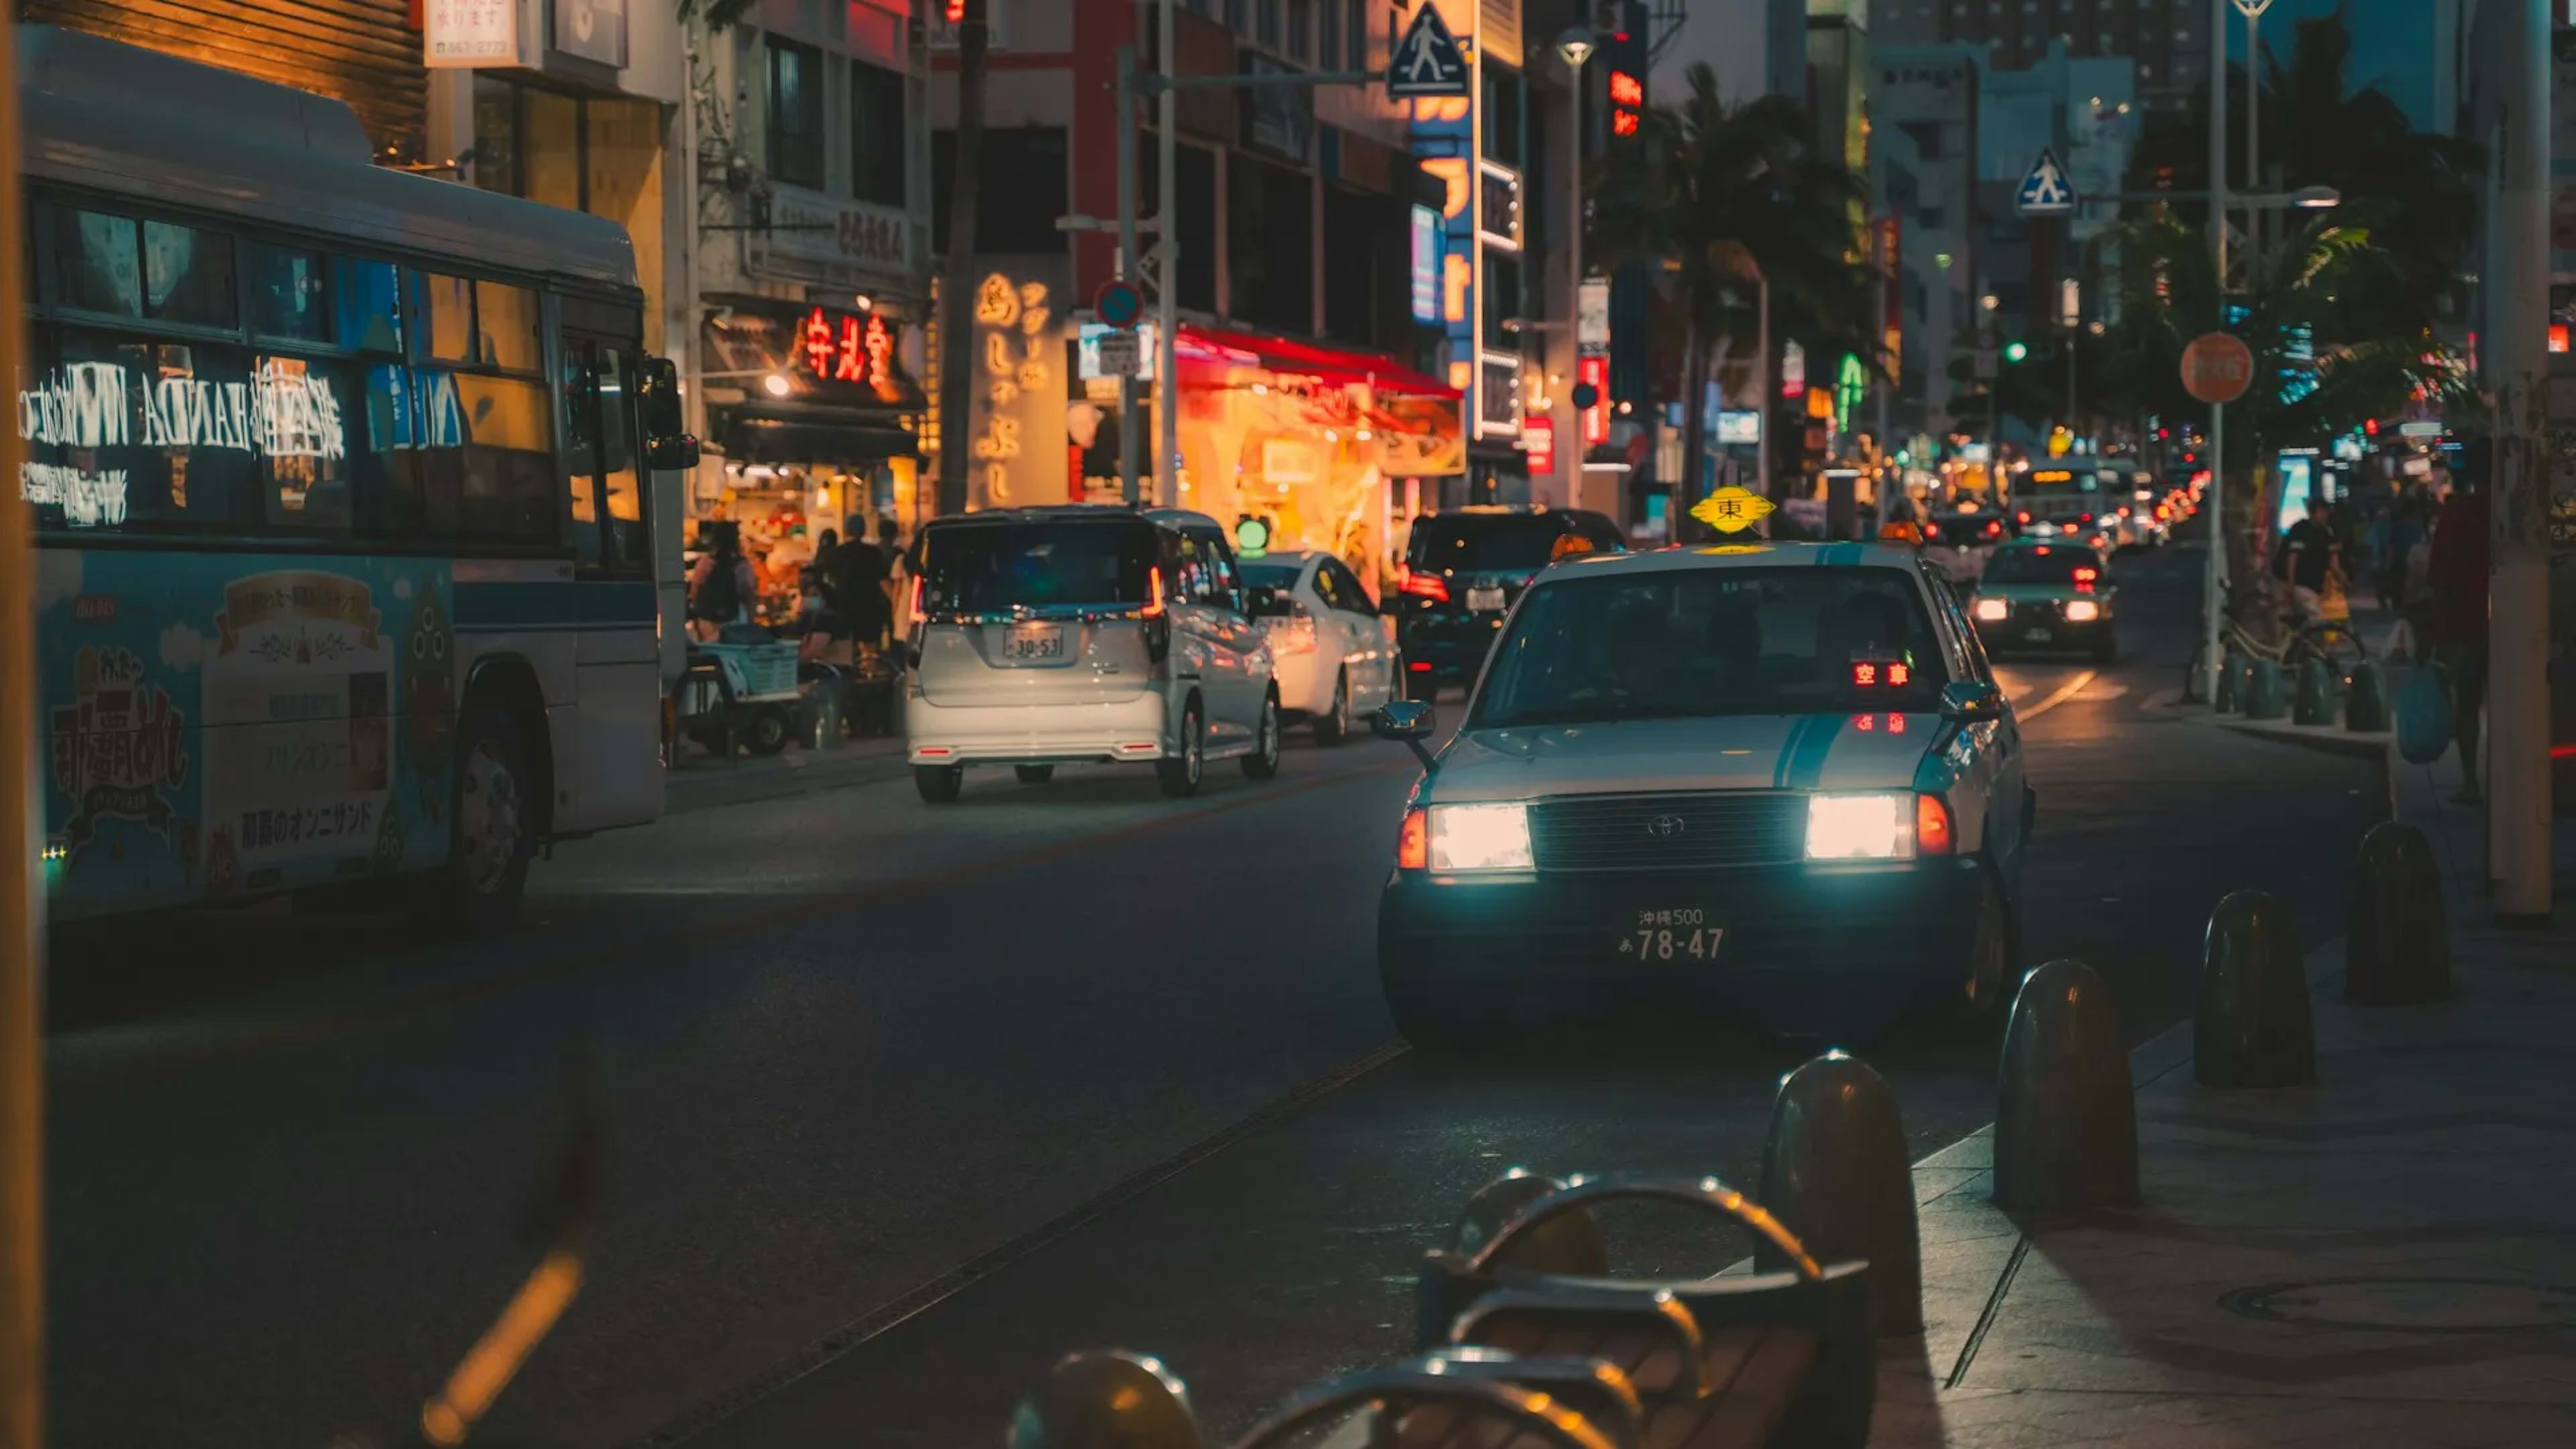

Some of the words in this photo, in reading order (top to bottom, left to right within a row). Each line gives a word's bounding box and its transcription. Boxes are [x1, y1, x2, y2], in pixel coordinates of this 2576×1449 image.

[1717, 500, 1744, 520] 東
[1855, 663, 1909, 684] 空車
[1637, 928, 1723, 961] 78-47
